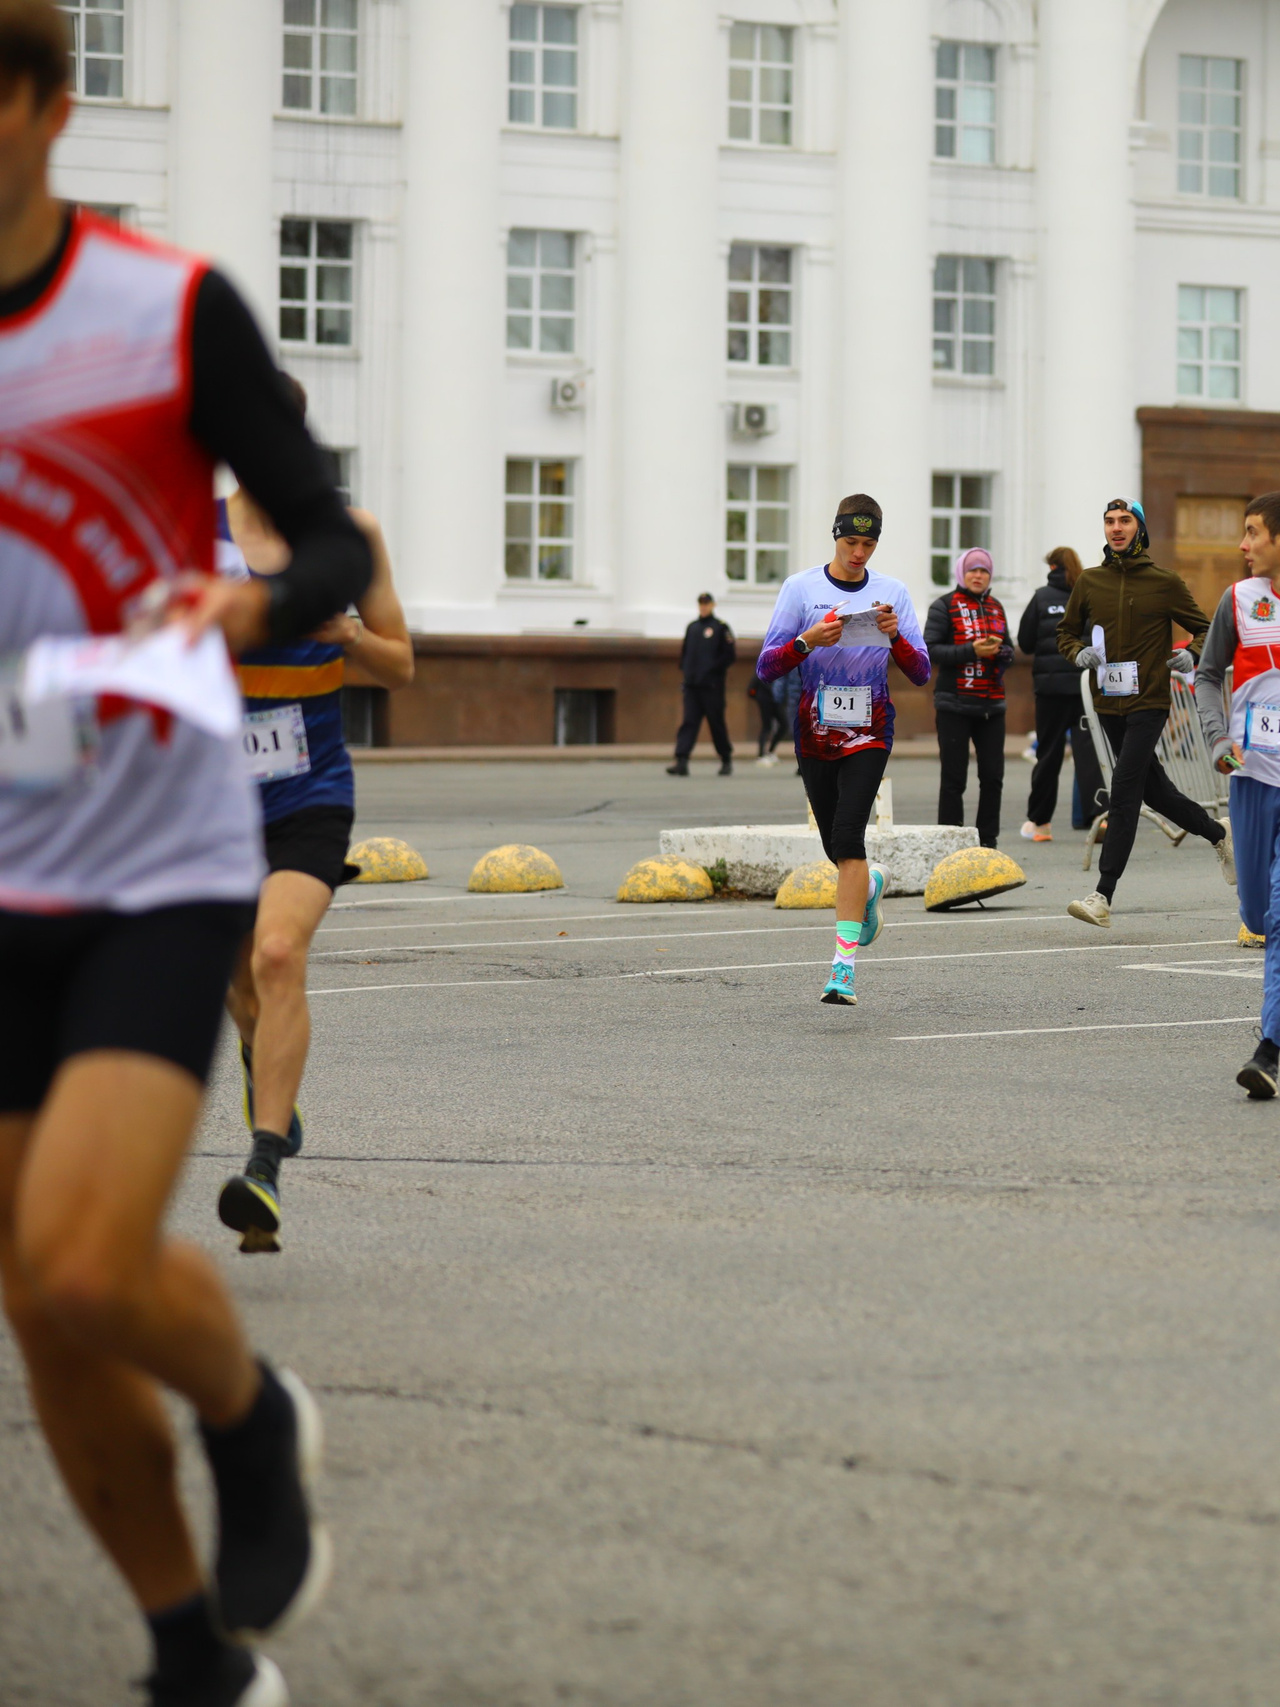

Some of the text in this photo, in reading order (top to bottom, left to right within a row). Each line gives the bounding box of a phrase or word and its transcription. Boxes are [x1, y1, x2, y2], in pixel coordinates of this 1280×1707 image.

[957, 601, 974, 640] WEST
[1108, 671, 1123, 683] 6.1
[833, 696, 855, 711] 9.1
